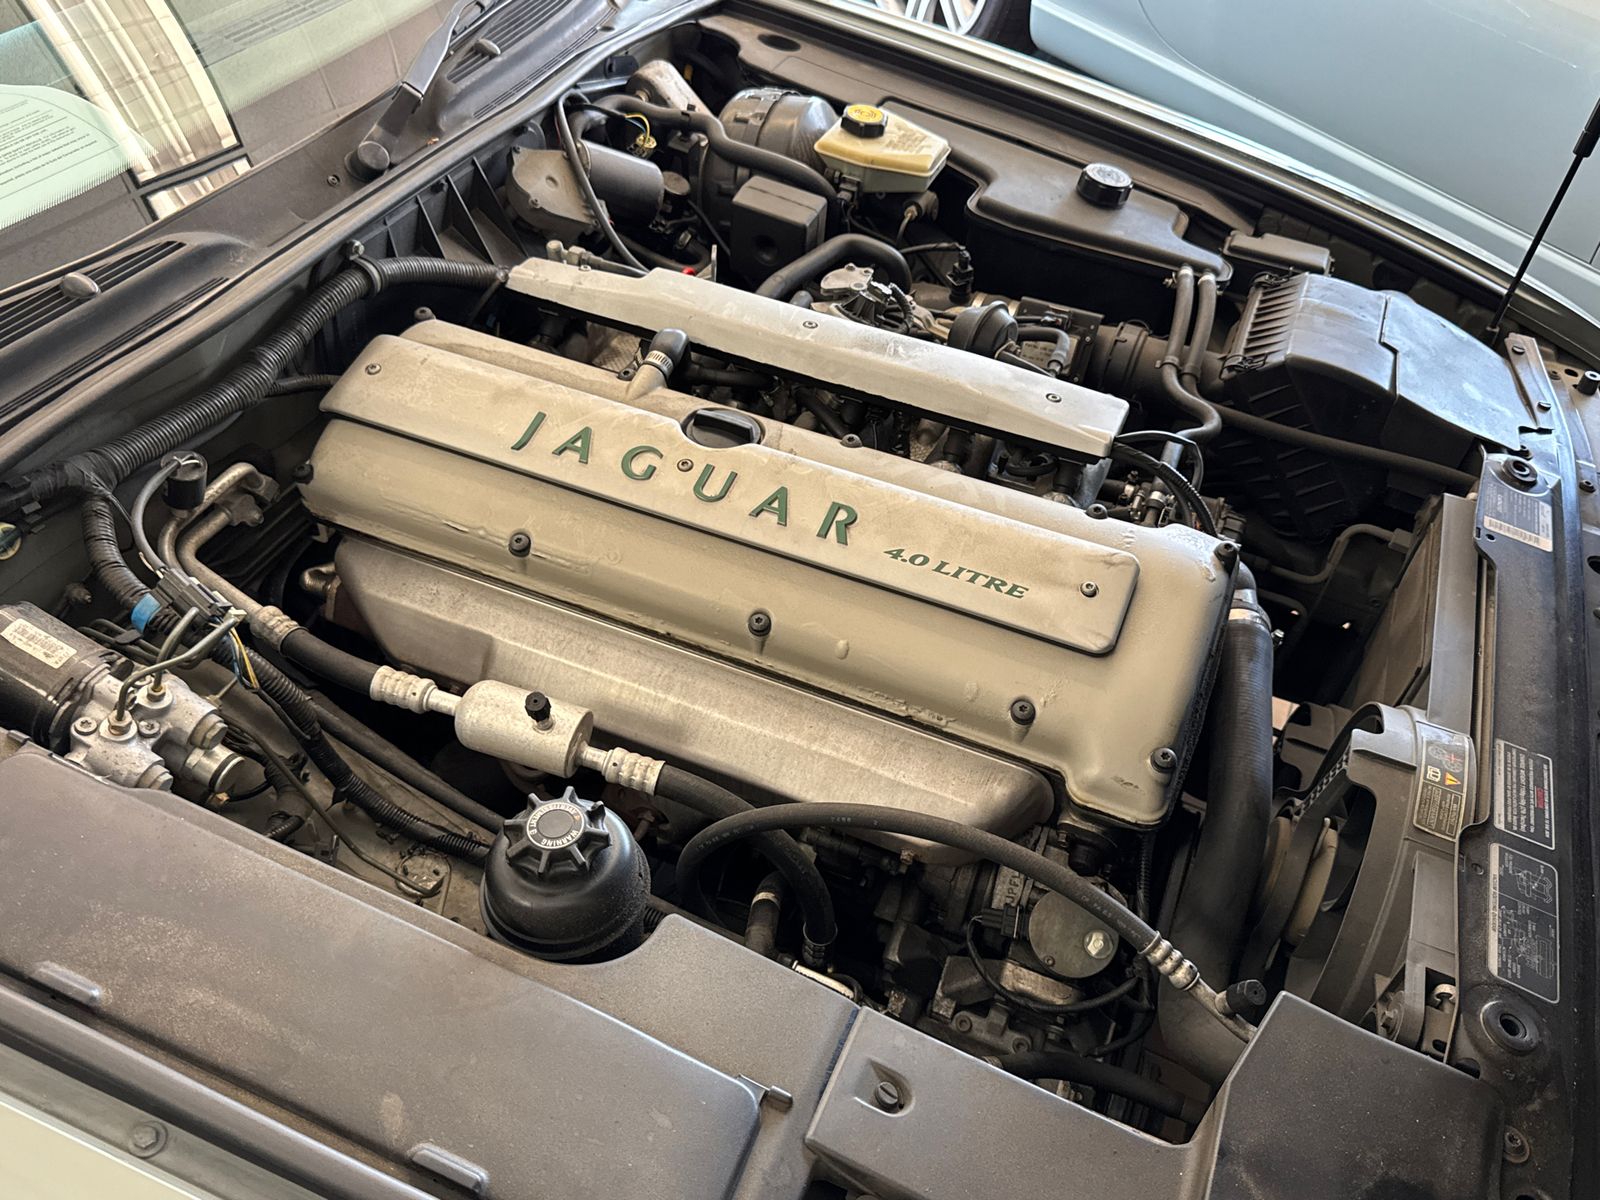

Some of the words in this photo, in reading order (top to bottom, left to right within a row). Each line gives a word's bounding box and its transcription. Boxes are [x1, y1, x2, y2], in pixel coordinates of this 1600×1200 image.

[511, 411, 858, 546] JAGUAR
[884, 548, 930, 566] 4.0
[932, 560, 1029, 599] LITRE
[541, 830, 579, 847] WARNING
